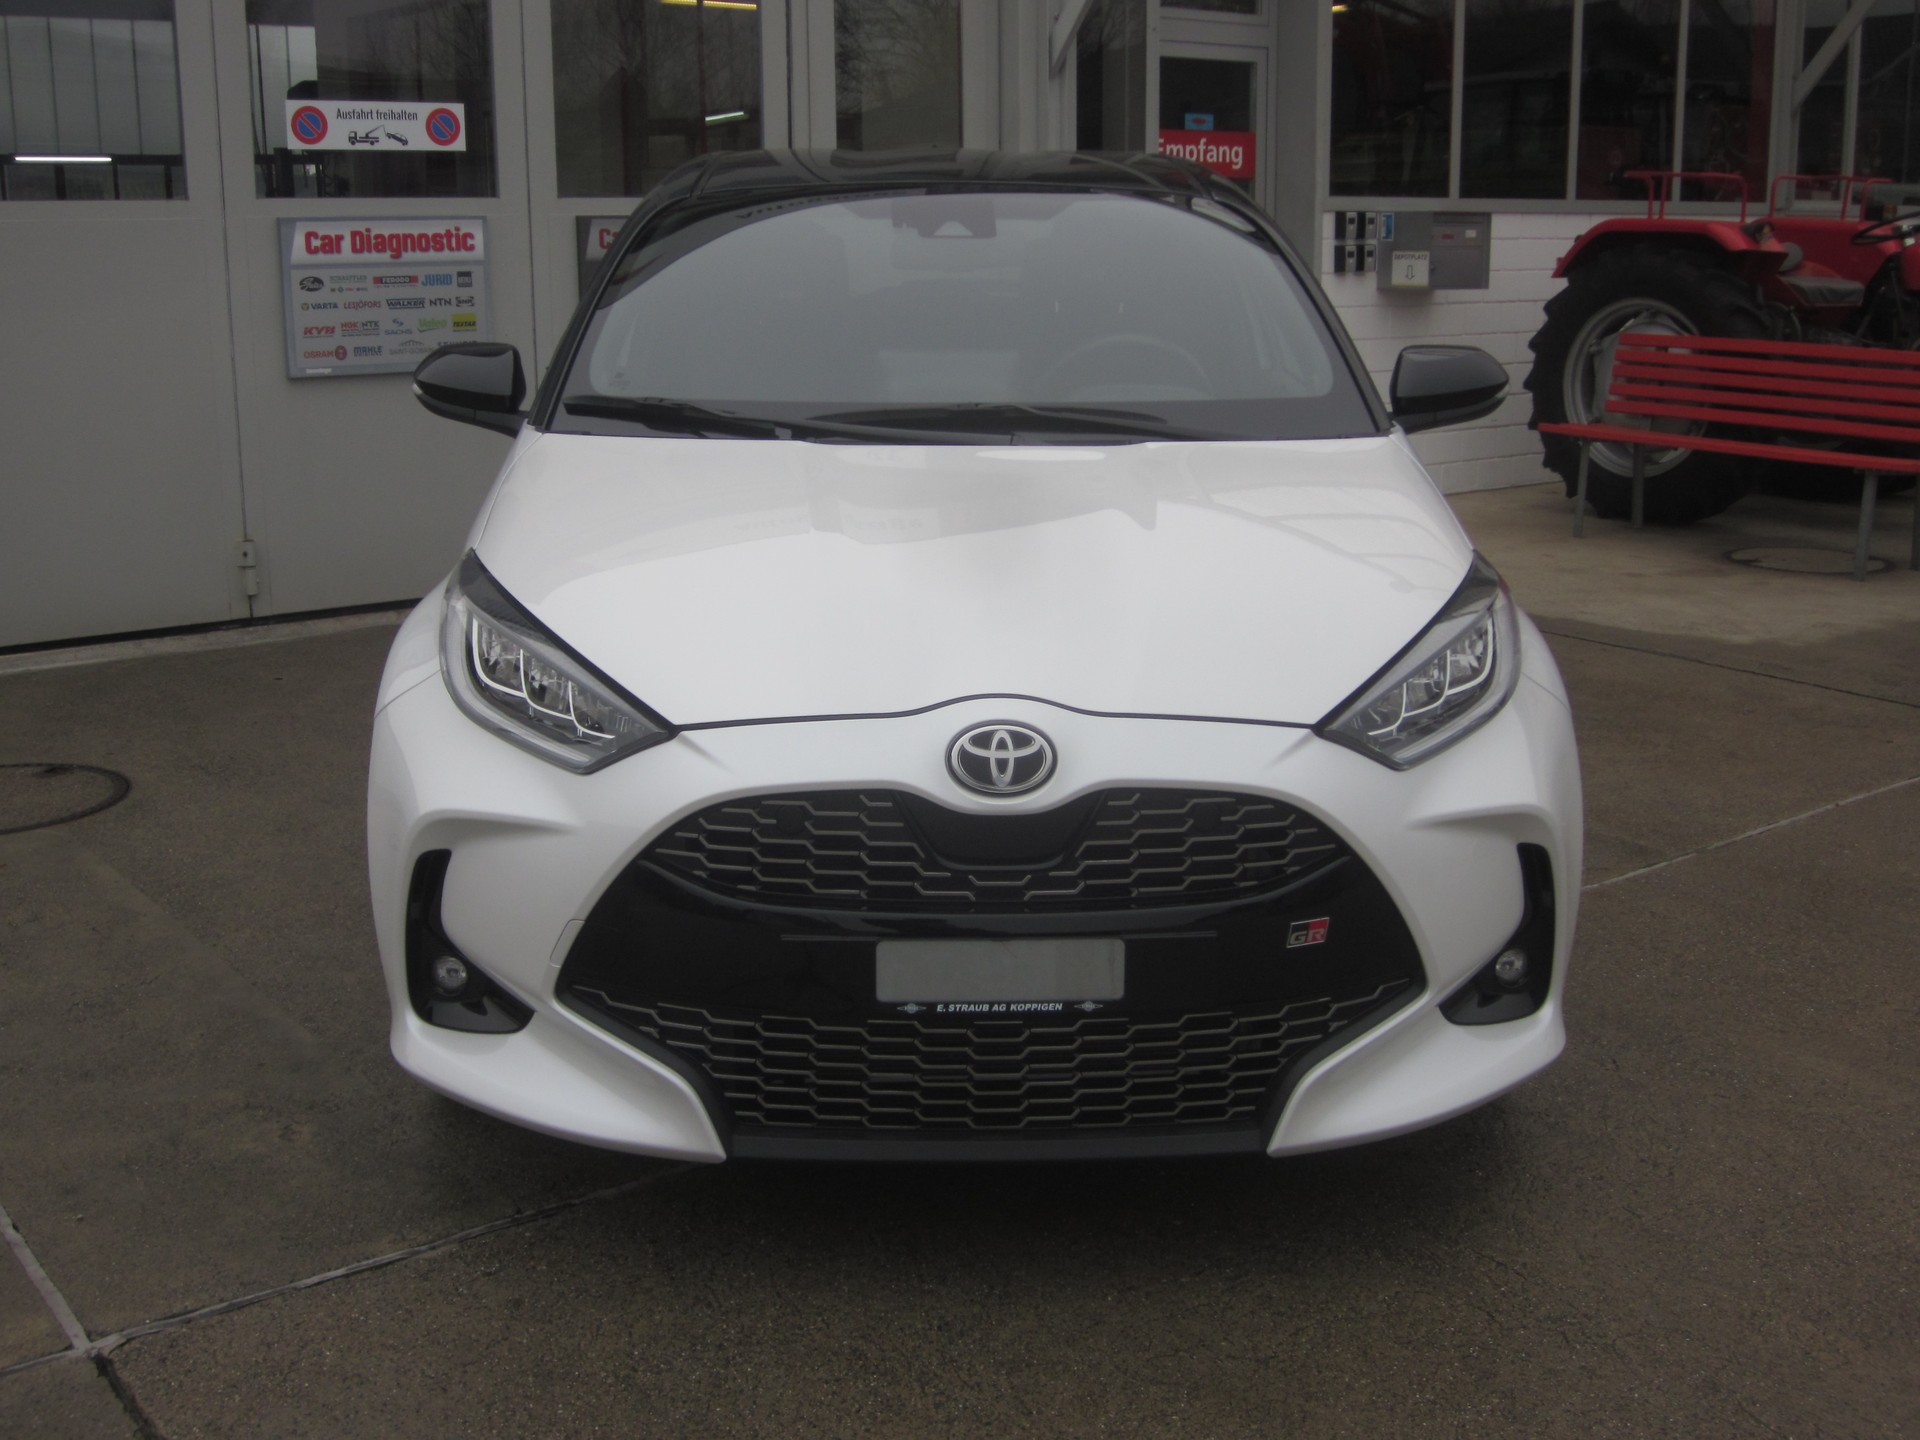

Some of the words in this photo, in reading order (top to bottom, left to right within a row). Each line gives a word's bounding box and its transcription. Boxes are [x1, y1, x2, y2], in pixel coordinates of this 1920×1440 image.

[336, 107, 374, 120] Ausfahrt
[375, 108, 418, 121] freihalten
[304, 230, 344, 255] Car
[350, 226, 475, 260] Diagnostic
[421, 274, 453, 286] JURID
[343, 300, 381, 310] LESJÖFORS
[386, 297, 425, 308] WALKER
[429, 298, 452, 306] NTN
[340, 321, 359, 329] NGK
[361, 320, 380, 328] NTK
[303, 326, 336, 335] KYB
[303, 350, 335, 358] OSRAM
[1290, 928, 1326, 944] GR
[936, 1003, 946, 1012] E.
[948, 1003, 989, 1012] STRAUB
[991, 1003, 1006, 1012] AG
[1010, 1002, 1063, 1012] KOPPIGEN
